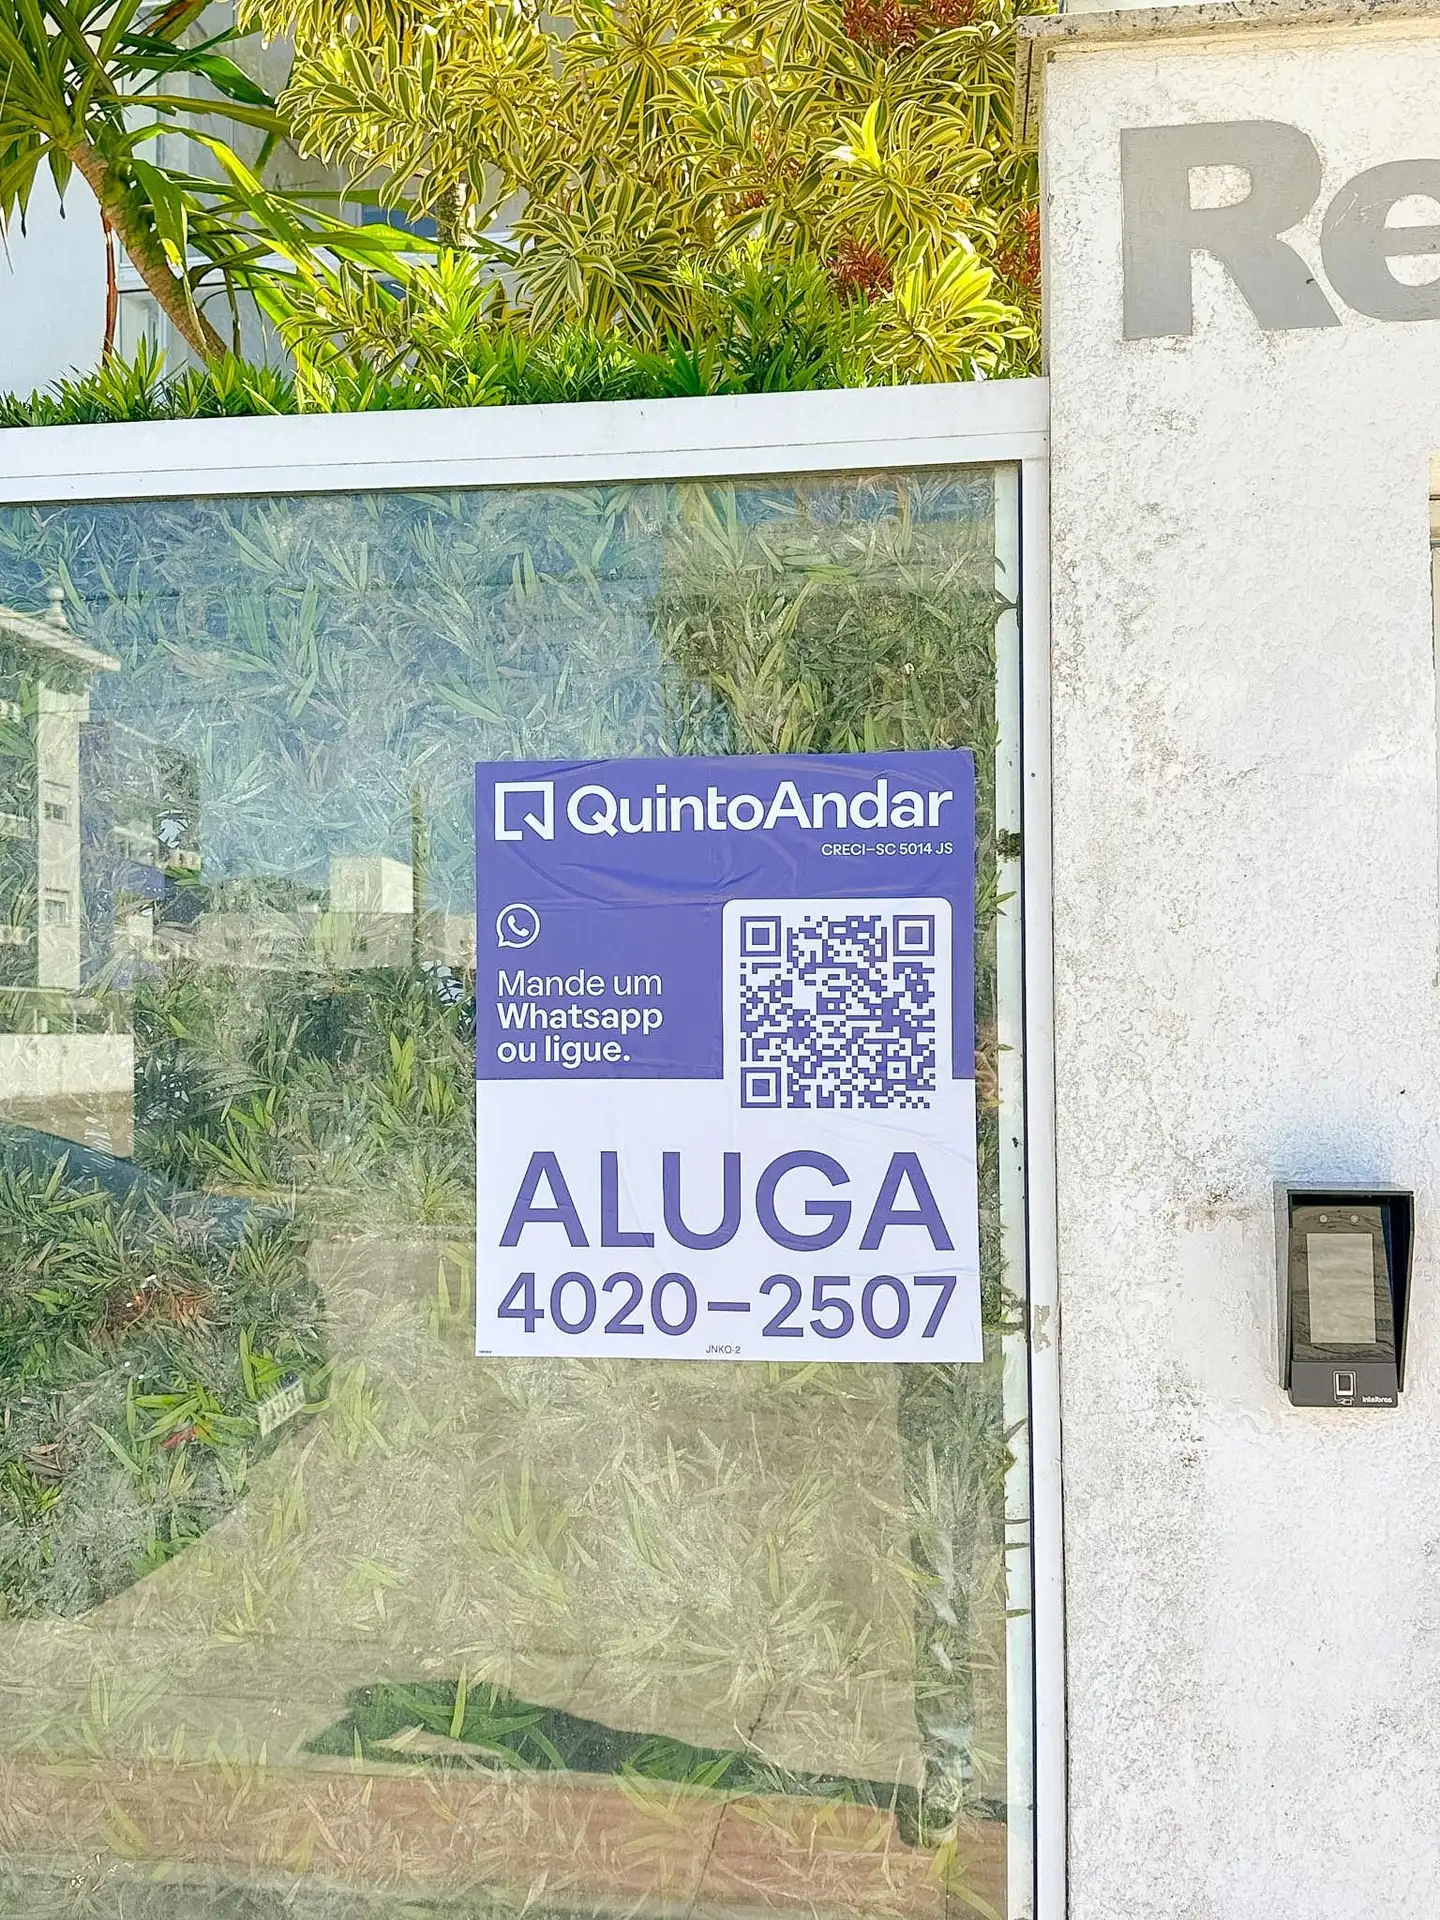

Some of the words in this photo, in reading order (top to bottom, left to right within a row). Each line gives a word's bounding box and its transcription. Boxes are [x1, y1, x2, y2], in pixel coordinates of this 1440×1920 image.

[1120, 119, 1440, 341] Re
[566, 778, 953, 837] QuintoAndar
[821, 842, 896, 856] CRECI-SC
[899, 842, 932, 855] 5014
[935, 842, 953, 855] JS
[498, 969, 606, 997] Mande
[613, 974, 663, 996] um
[496, 1002, 664, 1036] Whatsapp
[497, 1041, 536, 1063] ou
[545, 1034, 631, 1069] ligue.
[499, 1150, 955, 1251] ALUGA
[498, 1271, 957, 1340] 4020-2507
